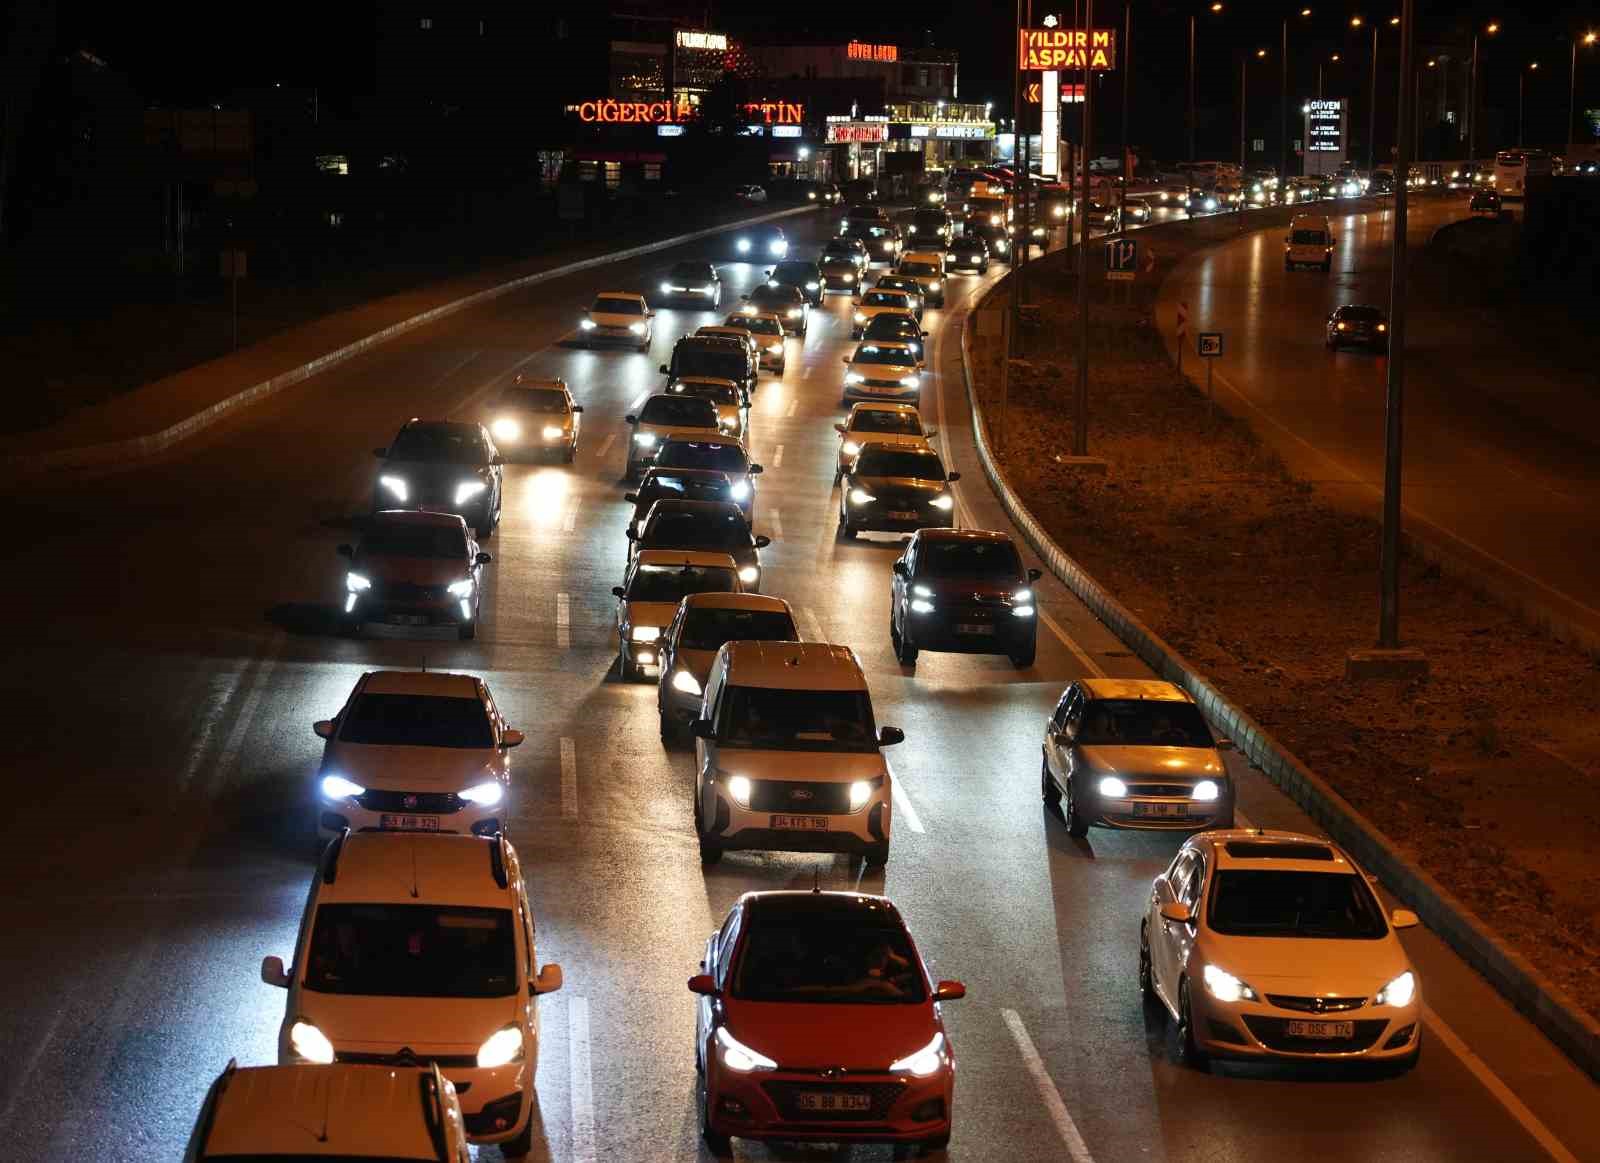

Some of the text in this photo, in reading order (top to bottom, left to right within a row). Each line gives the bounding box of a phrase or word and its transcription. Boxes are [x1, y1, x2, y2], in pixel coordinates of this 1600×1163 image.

[1025, 32, 1109, 47] YILDIRM
[580, 99, 673, 123] CİĞERCİ
[1311, 100, 1340, 110] GÜVEN
